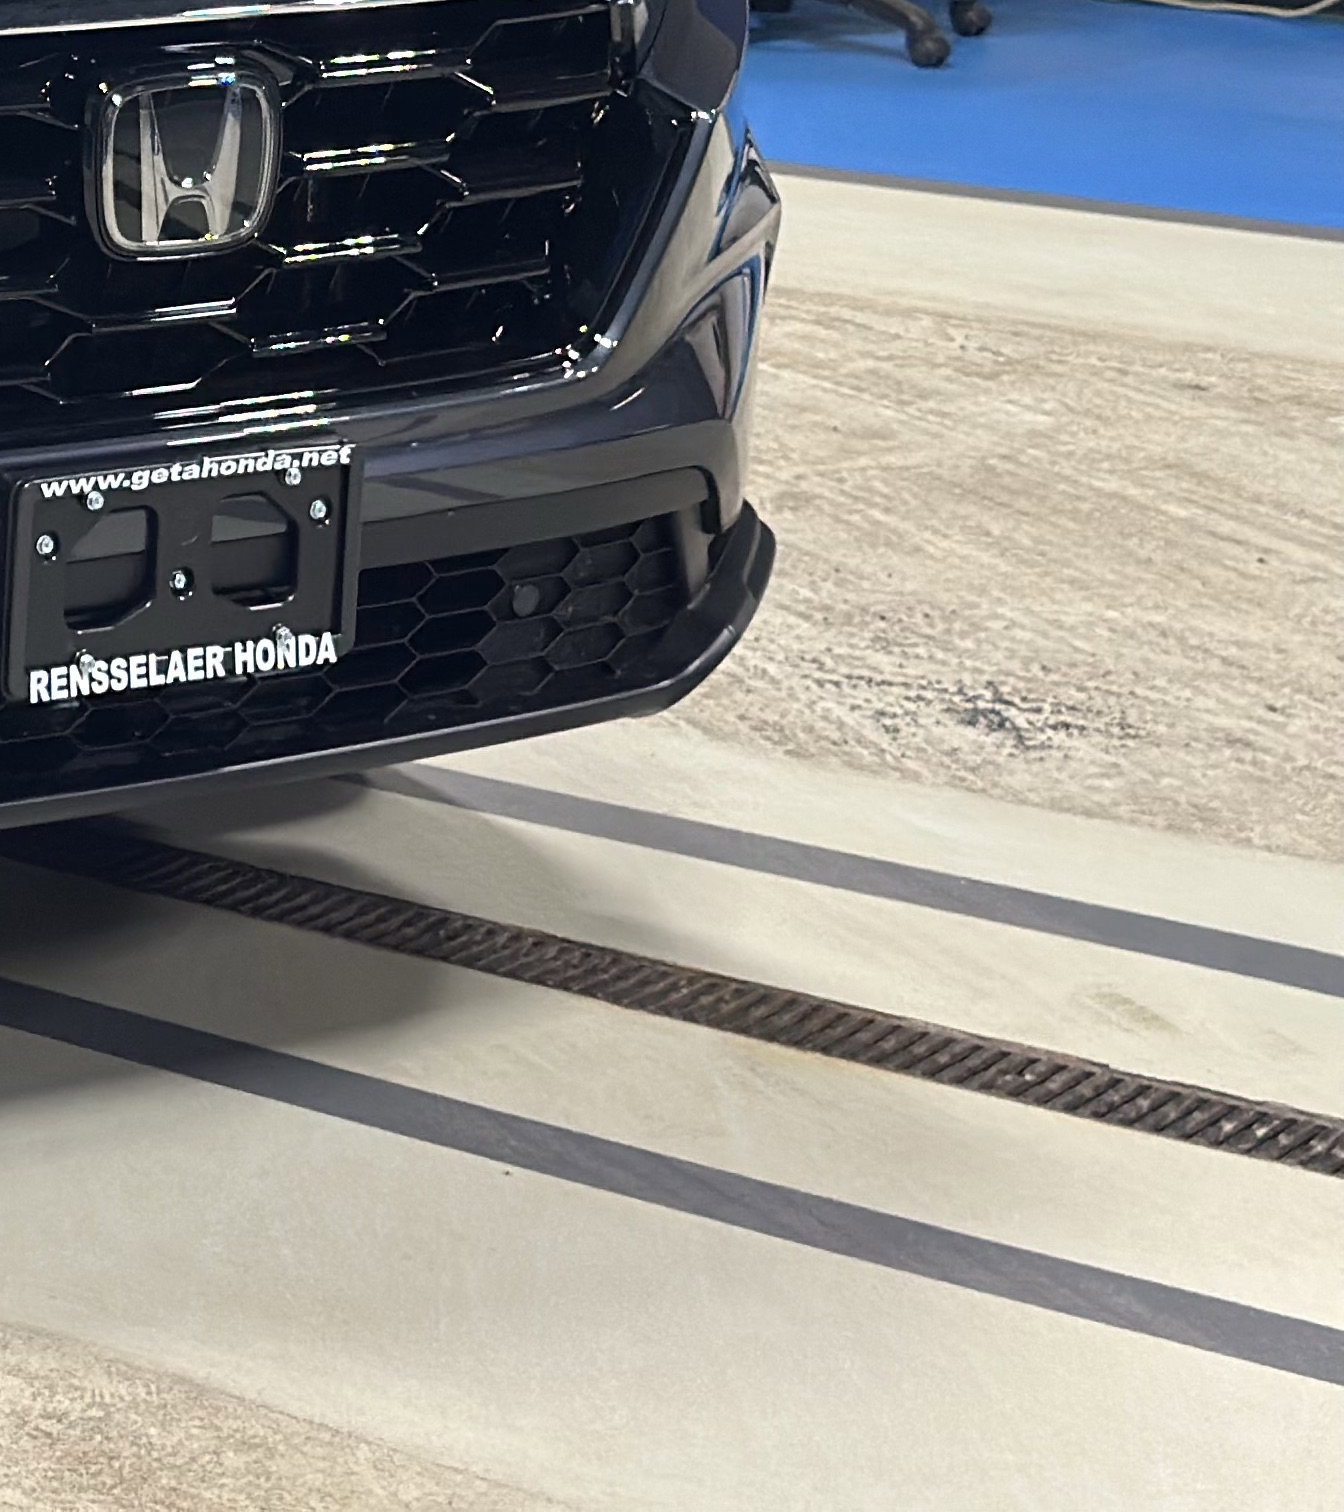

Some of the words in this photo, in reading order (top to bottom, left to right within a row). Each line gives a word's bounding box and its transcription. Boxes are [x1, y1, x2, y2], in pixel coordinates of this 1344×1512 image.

[40, 444, 352, 499] www.getahonda.net
[29, 646, 224, 704] RENSSELAER
[234, 631, 338, 676] HONDA
